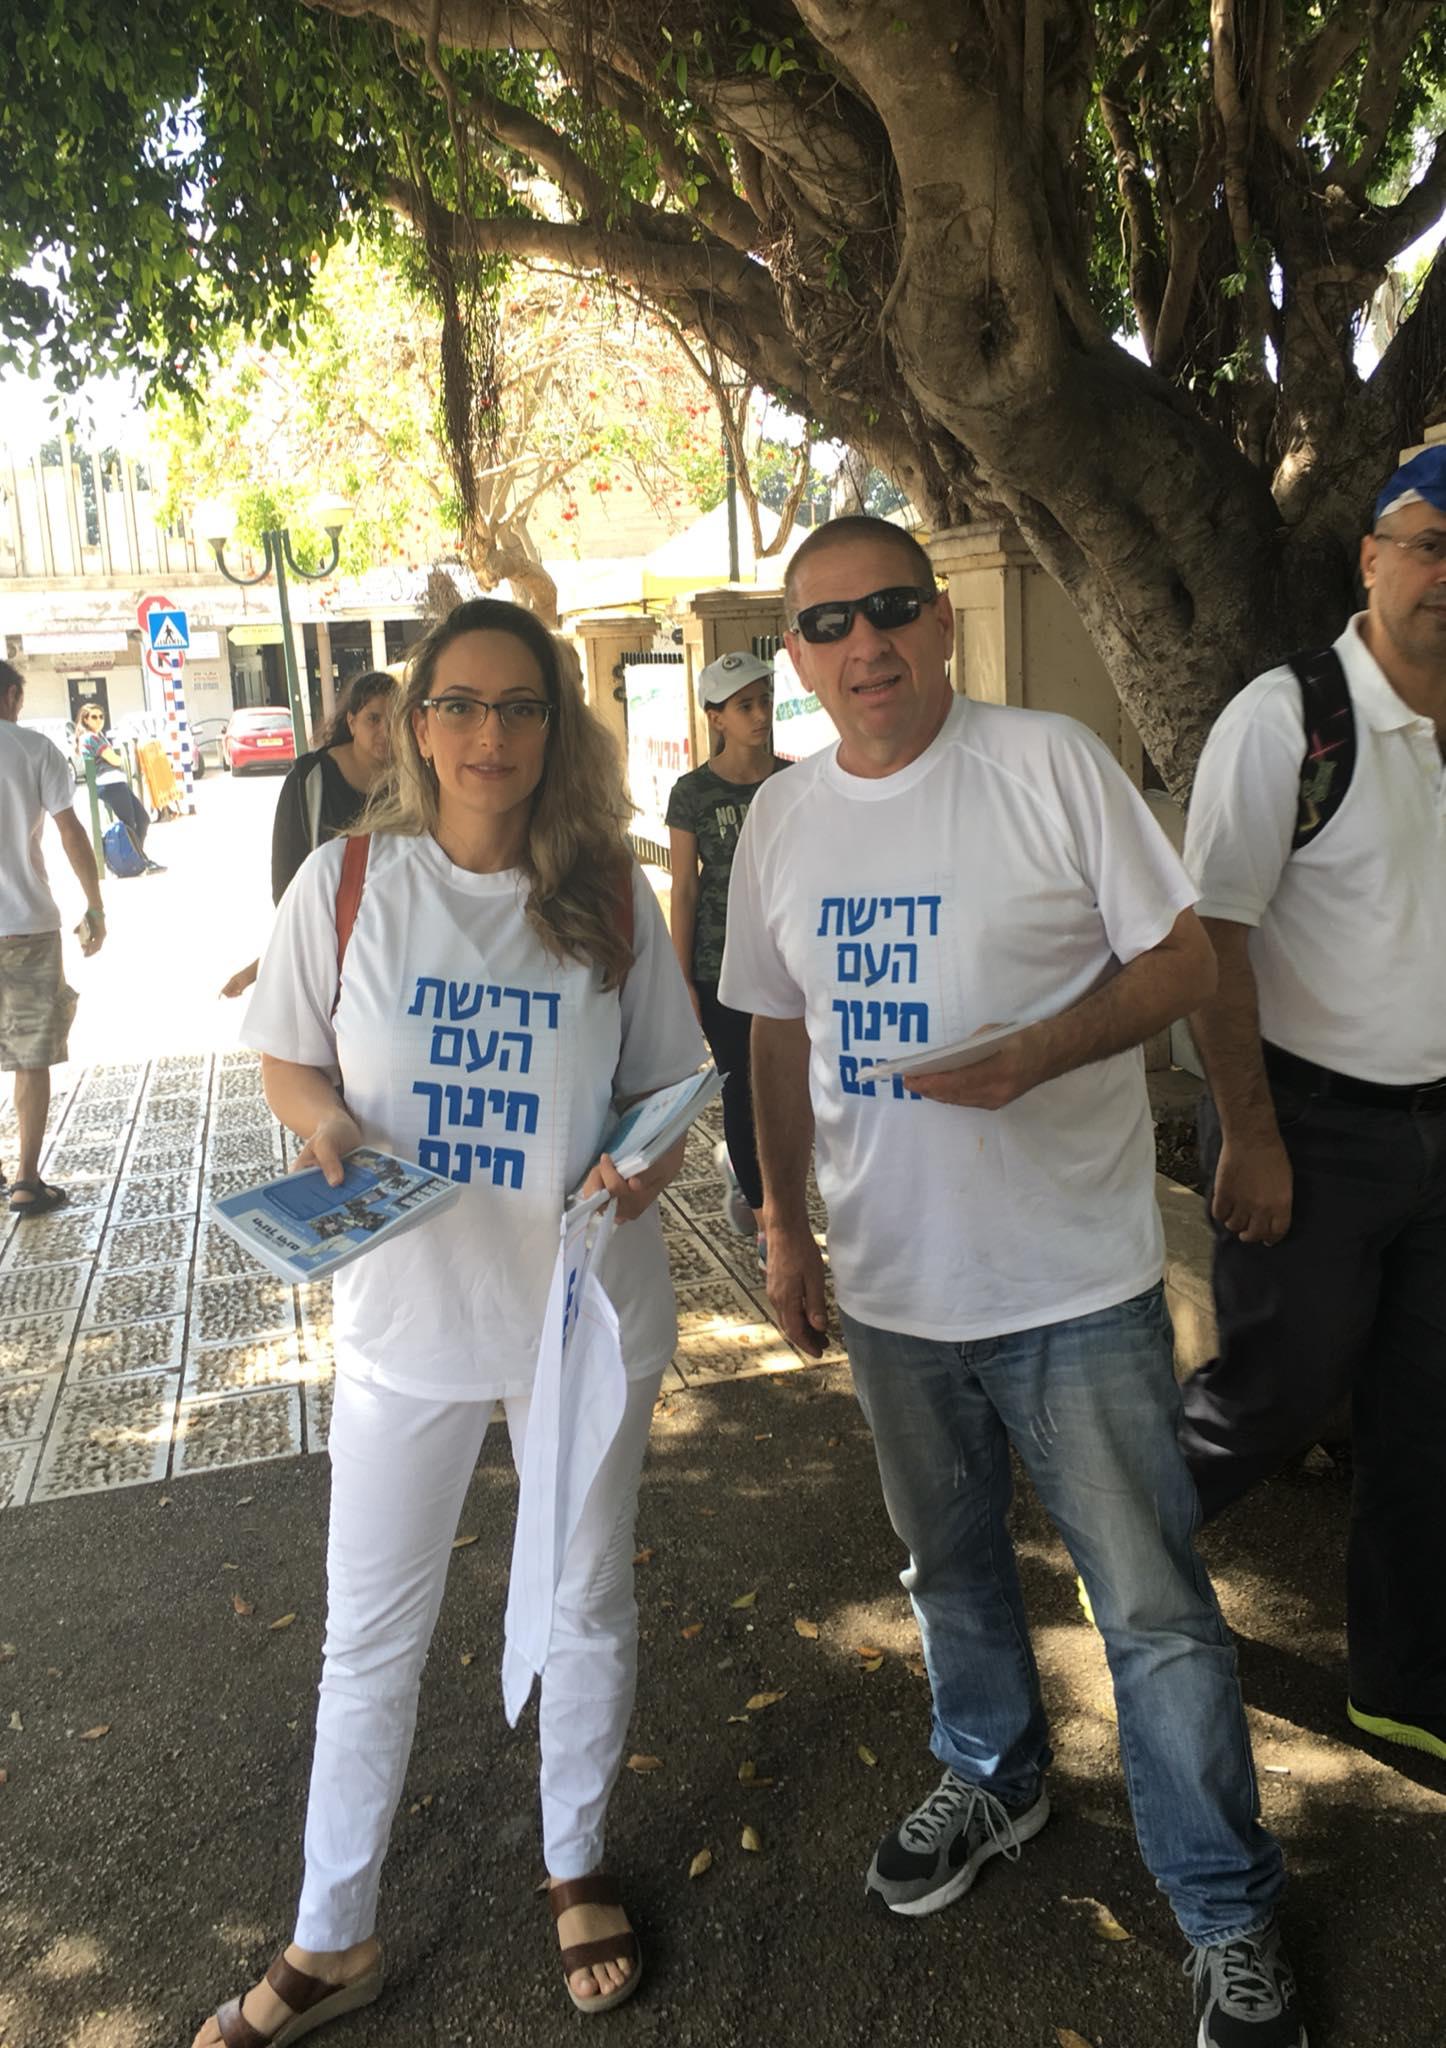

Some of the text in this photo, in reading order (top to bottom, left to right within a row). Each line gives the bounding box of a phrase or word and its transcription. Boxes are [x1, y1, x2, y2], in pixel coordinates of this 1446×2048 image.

[715, 805, 737, 826] NO
[817, 896, 941, 936] דרישת
[837, 943, 917, 987] העם
[408, 977, 561, 1029] דרישת
[832, 999, 928, 1051] חינוך
[430, 1025, 533, 1074] העם
[412, 1081, 540, 1136] חינוך
[418, 1138, 525, 1190] חינם
